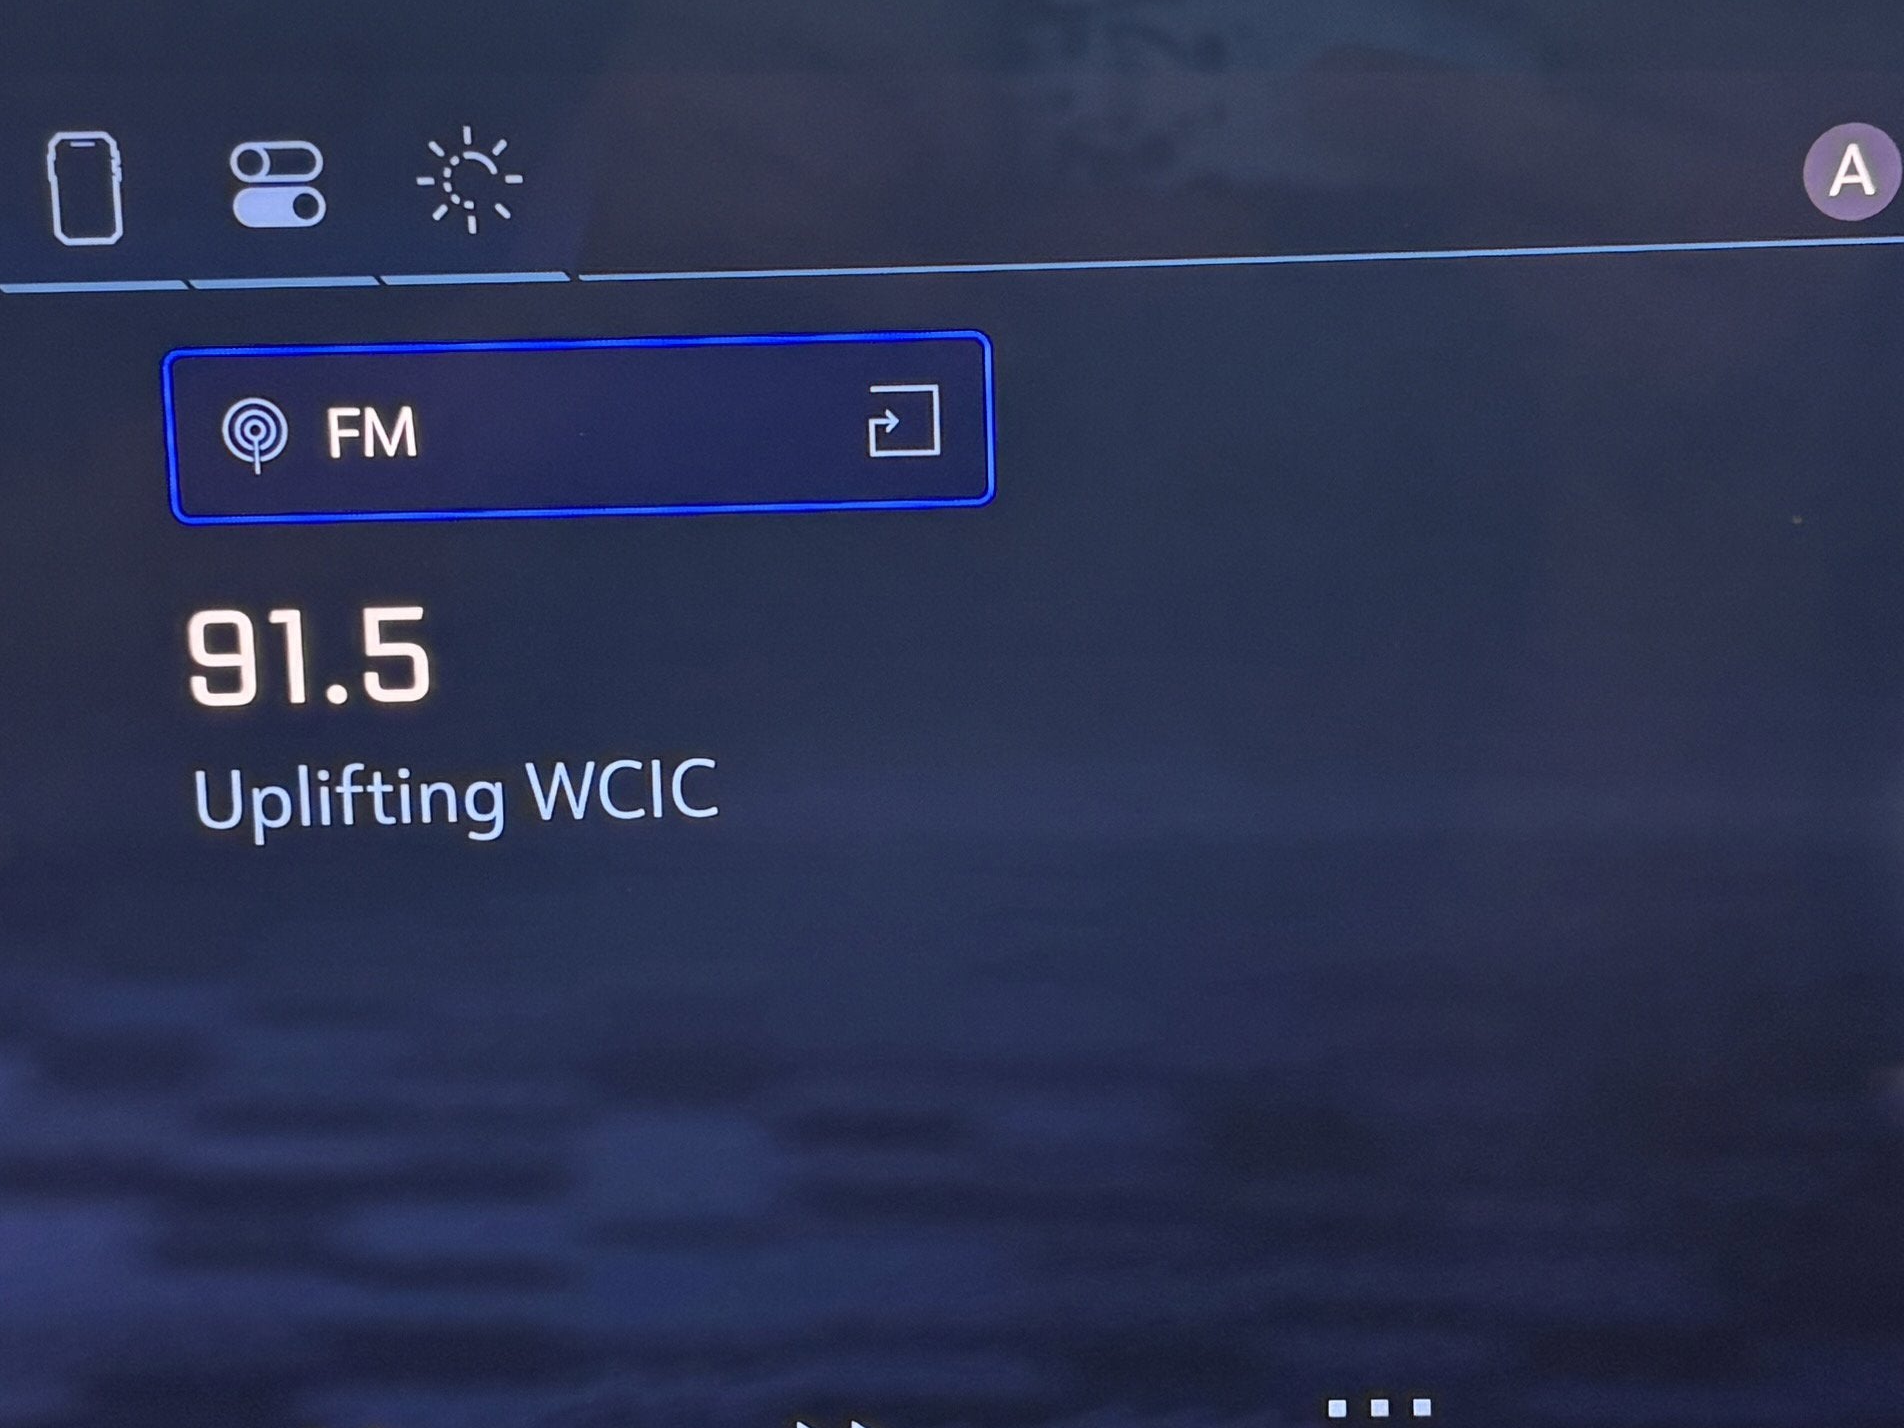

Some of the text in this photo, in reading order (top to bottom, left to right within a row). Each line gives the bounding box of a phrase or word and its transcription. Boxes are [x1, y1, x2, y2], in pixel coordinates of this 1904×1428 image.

[1828, 143, 1876, 197] A
[327, 405, 418, 459] FM
[187, 606, 431, 707] 91.5
[195, 757, 719, 846] Uplifting WCIC
